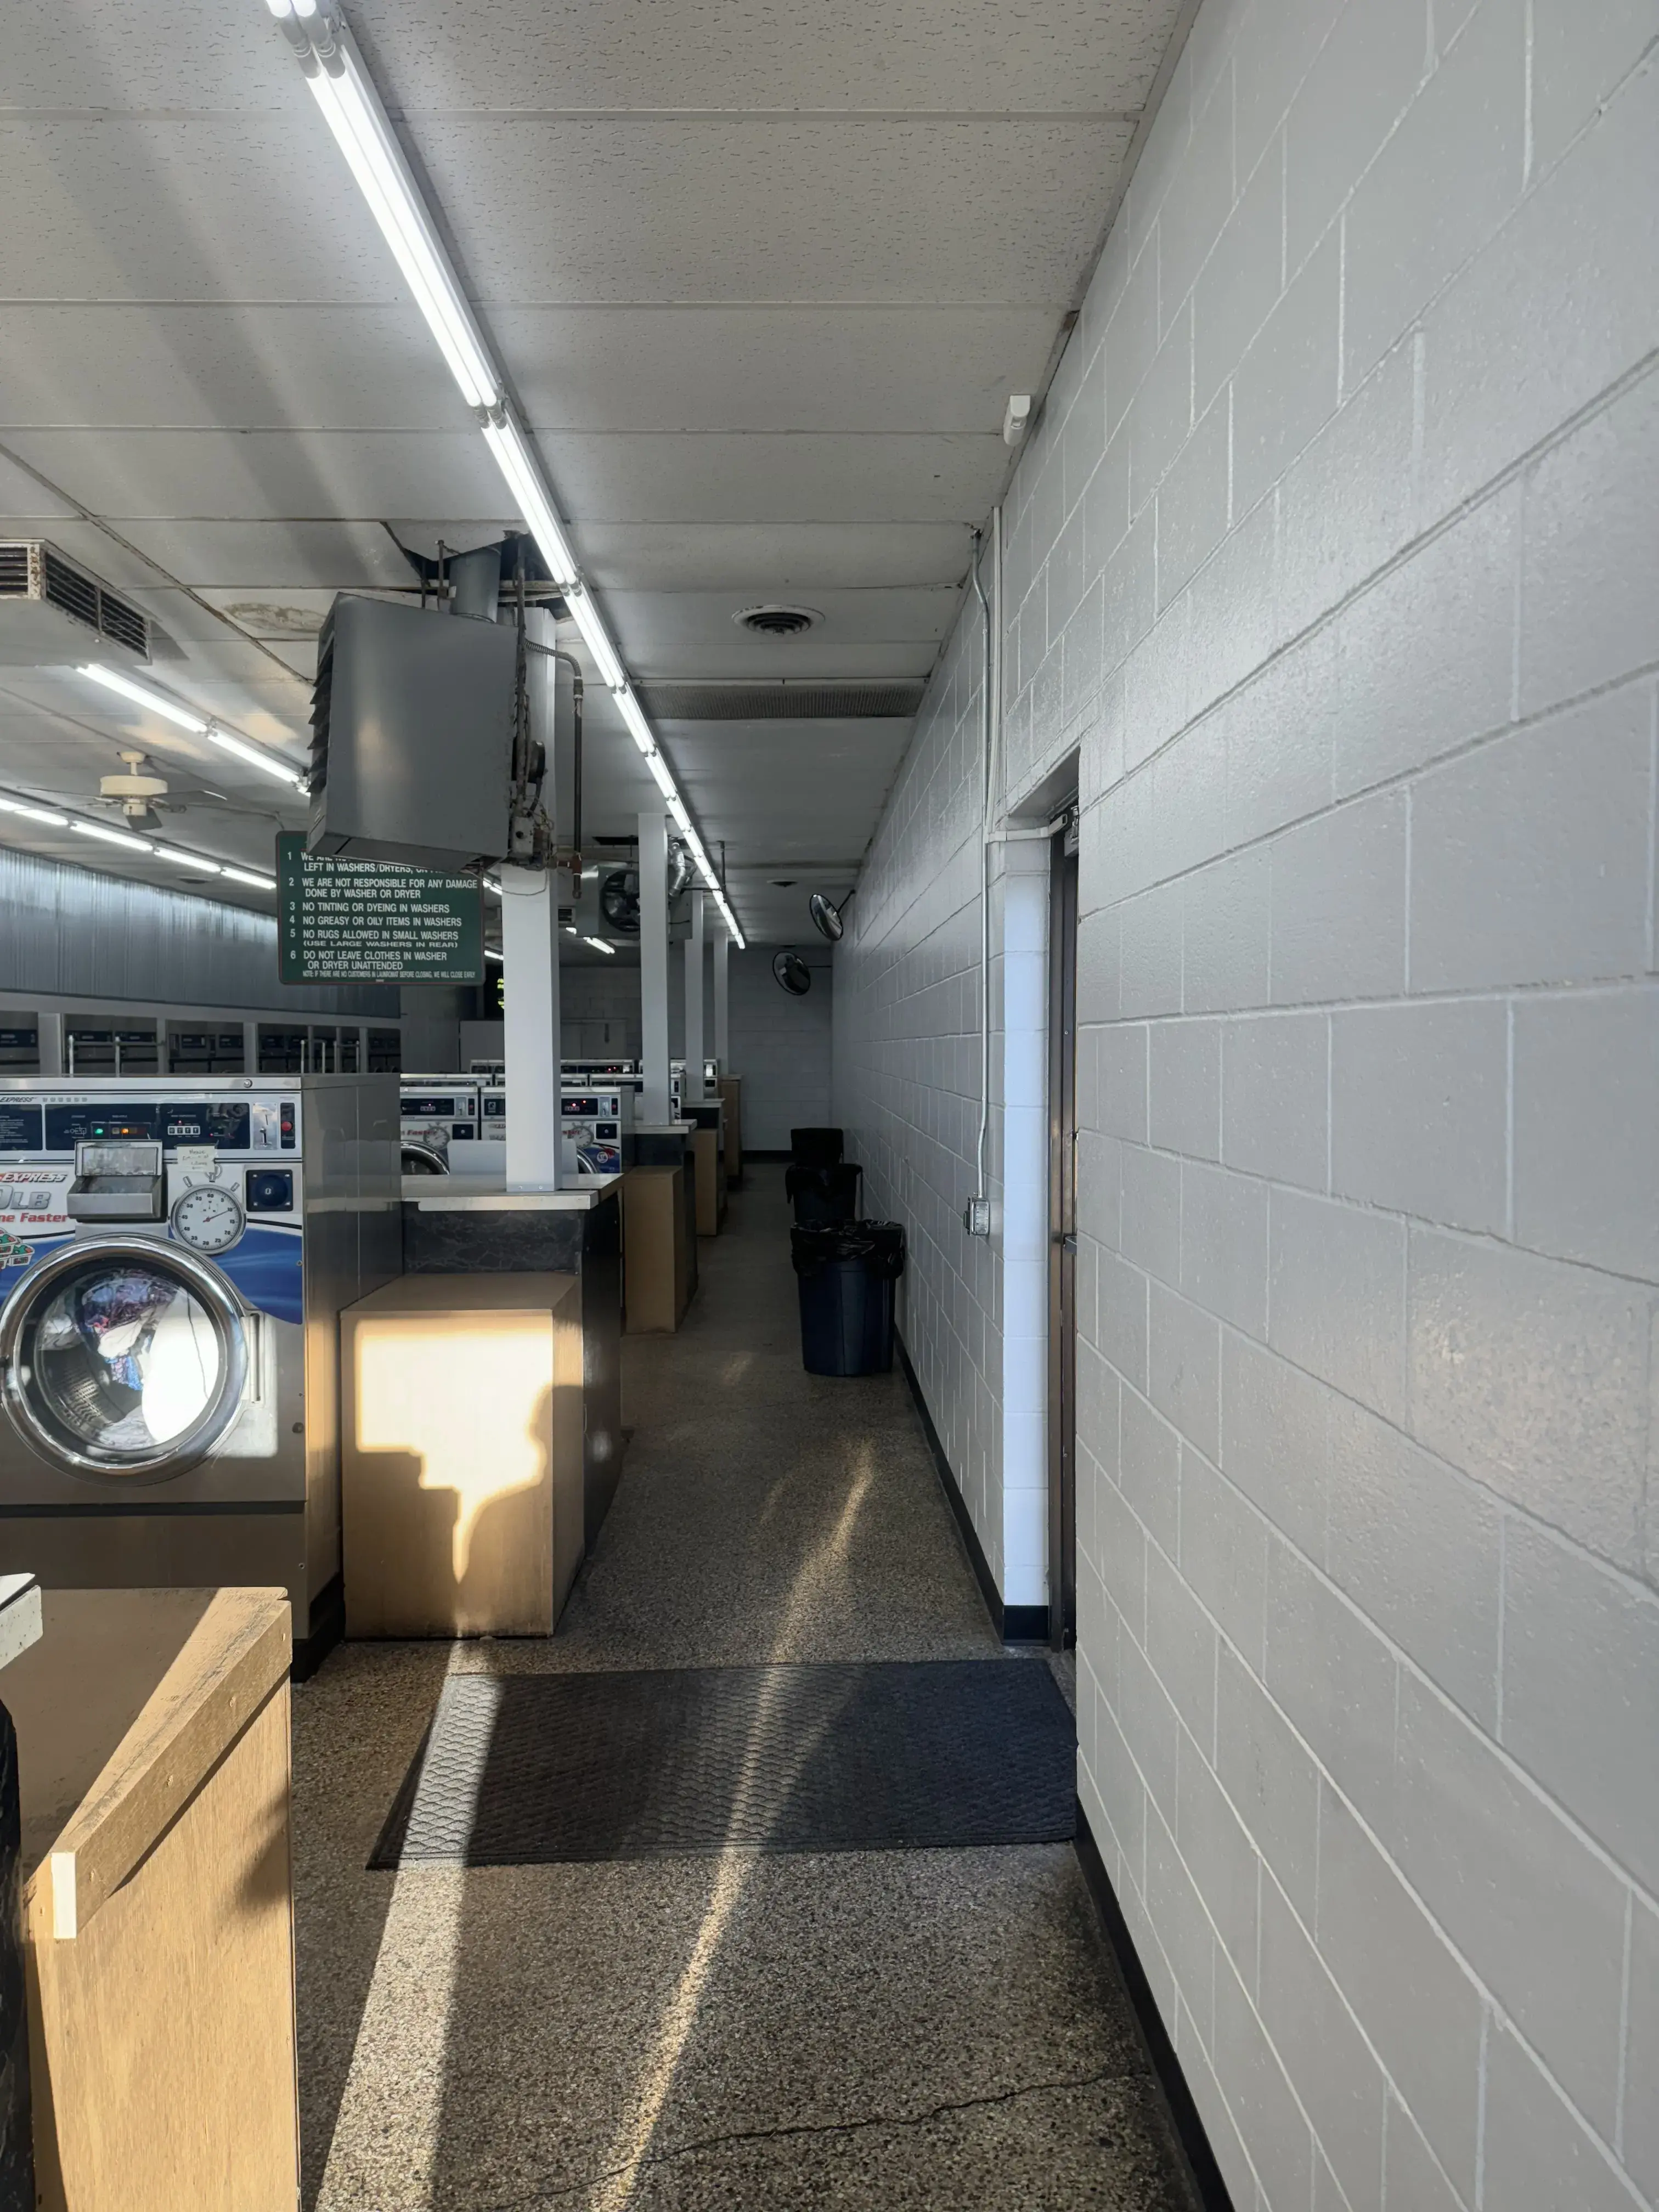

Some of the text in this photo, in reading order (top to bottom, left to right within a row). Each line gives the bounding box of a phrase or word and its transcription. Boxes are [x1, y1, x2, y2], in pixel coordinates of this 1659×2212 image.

[304, 862, 323, 871] LEFT
[326, 863, 334, 871] IN
[289, 878, 477, 888] 2 WE ARE NOT RESPONSIBLE FOR ANY DAMAGE
[306, 889, 420, 898] DONE BY WASHER OR DRYER
[290, 902, 295, 910] 3
[303, 902, 314, 911] NO
[318, 902, 349, 911] TINTING
[352, 903, 364, 911] OR
[367, 904, 397, 912] DYEING
[411, 904, 449, 912] WASHERS
[303, 916, 314, 924] NO
[318, 916, 349, 924] GREASY
[353, 917, 364, 925] OR
[367, 917, 383, 925] OILY
[386, 917, 410, 926] ITEMS
[413, 917, 421, 926] IN
[424, 918, 461, 926] WASHERS
[290, 929, 295, 937] 5
[303, 930, 314, 938] NO
[318, 930, 339, 939] RUGS
[342, 930, 379, 939] ALLOWED
[393, 931, 418, 939] SMALL
[421, 932, 458, 940] WASHERS
[291, 950, 296, 959] 6
[304, 951, 315, 959] DO
[319, 951, 334, 959] NOT
[337, 951, 361, 960] LEAVE
[364, 951, 400, 960] CLOTHES
[414, 952, 447, 960] WASHER
[352, 961, 403, 969] UNATTENDED
[1, 1172, 67, 1182] EXPRESS
[20, 1212, 67, 1222] Faster
